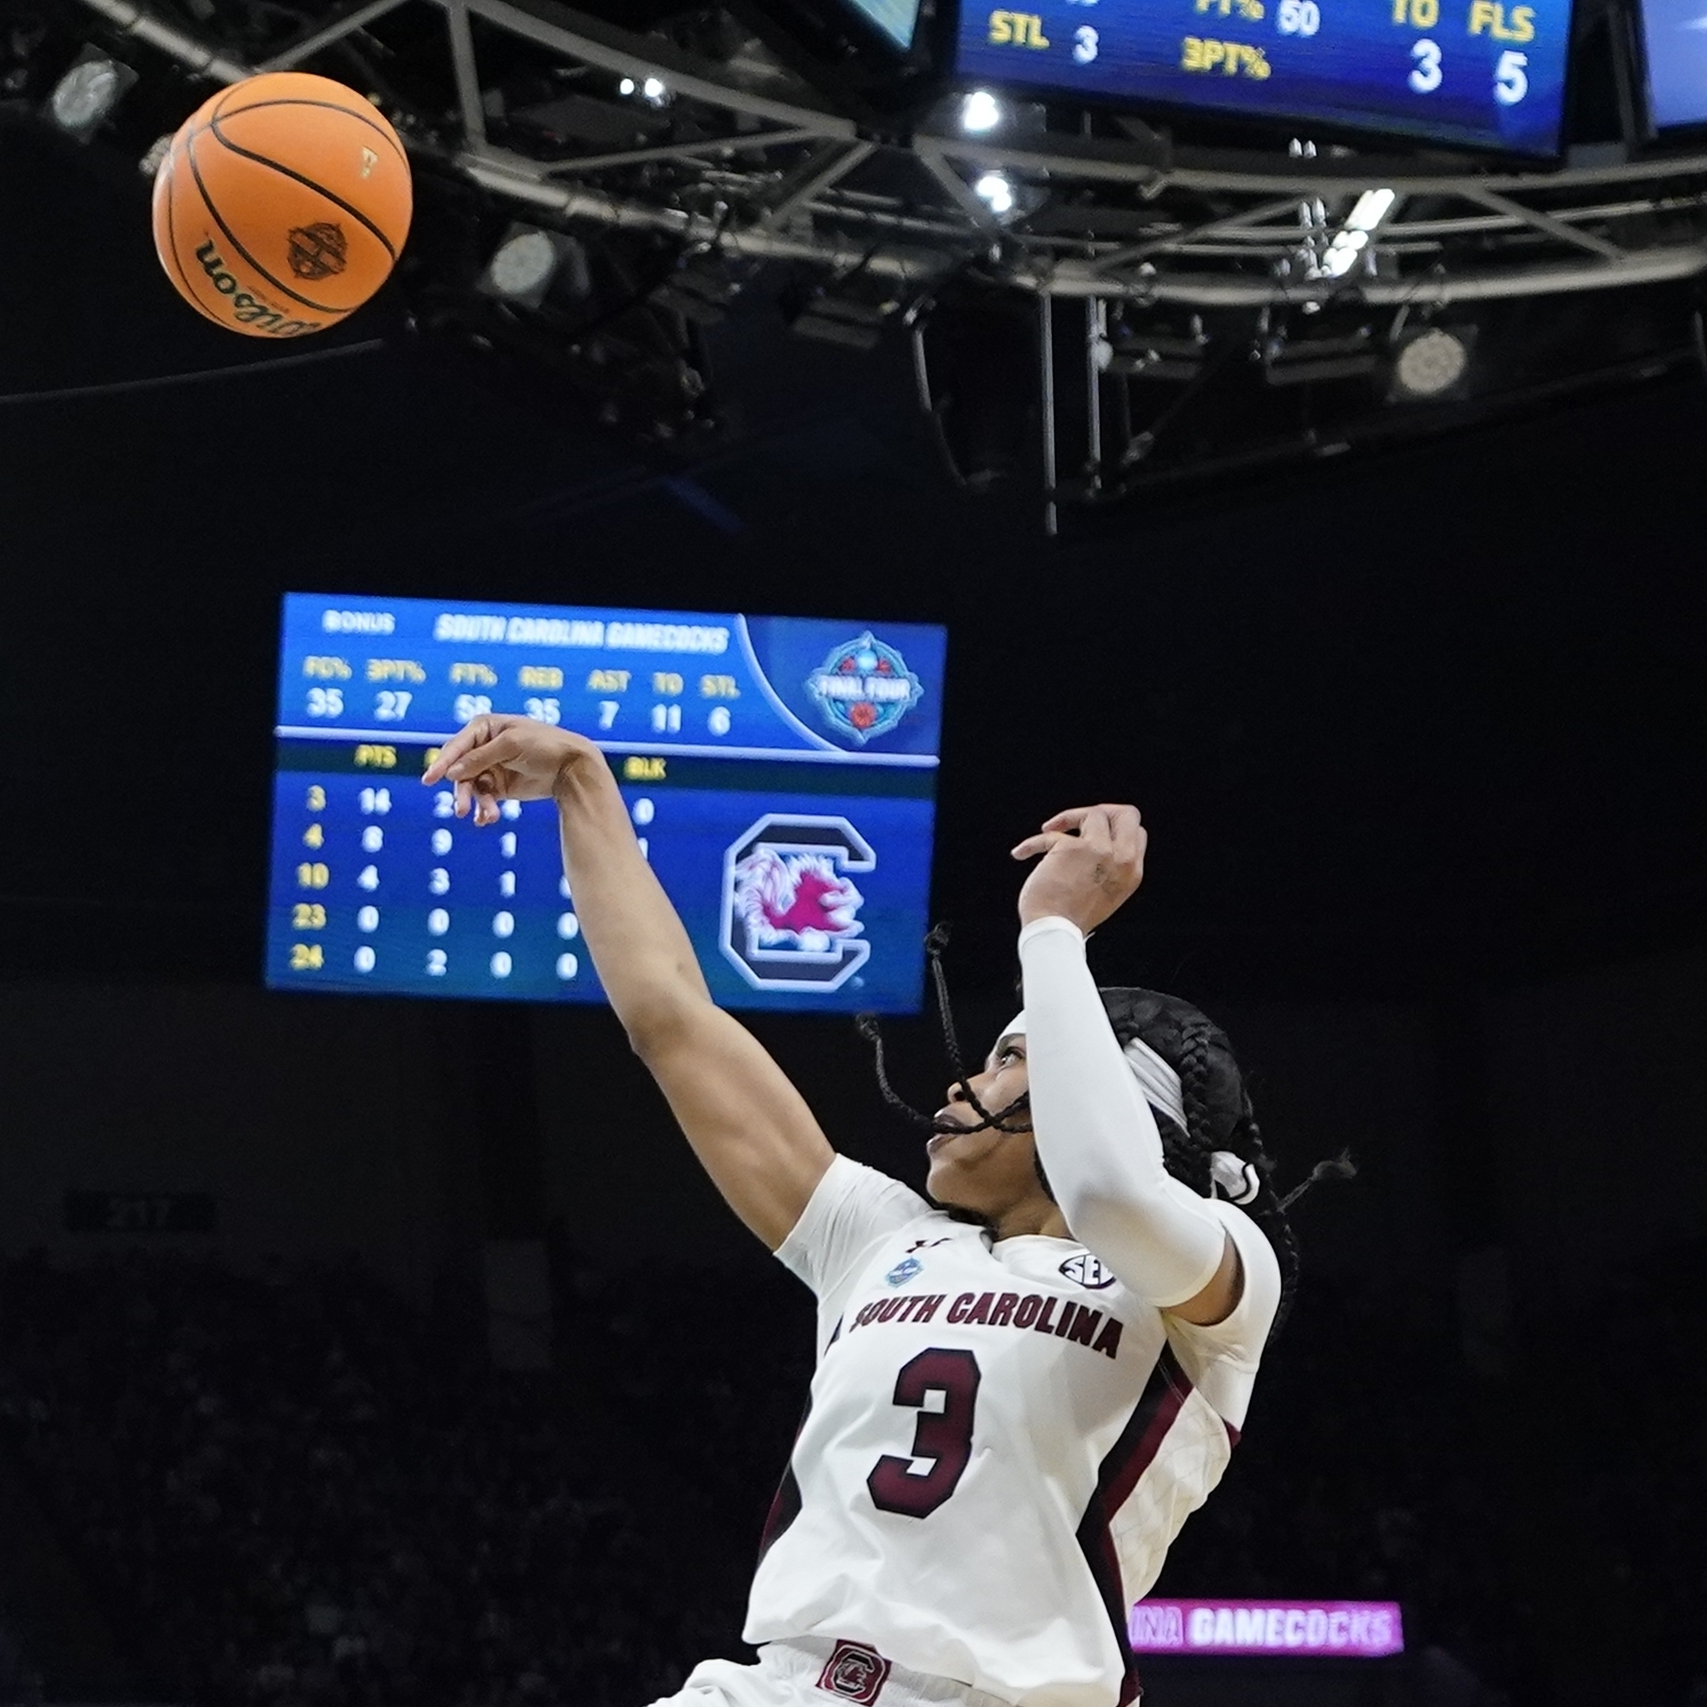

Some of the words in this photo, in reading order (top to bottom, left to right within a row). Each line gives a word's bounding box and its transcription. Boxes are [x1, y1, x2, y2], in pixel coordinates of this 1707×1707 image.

[989, 10, 1050, 49] STL
[1073, 25, 1099, 63] 3
[1468, 0, 1535, 42] FLS
[1182, 36, 1271, 80] 3PT%
[1409, 38, 1442, 93] 3
[1494, 50, 1528, 105] 5
[322, 610, 396, 635] BONUS
[437, 613, 507, 643] SOUTH
[508, 616, 604, 647] CAROLINA
[605, 621, 730, 655] GAMECOCKS
[303, 655, 352, 680] FG%
[366, 658, 426, 683] 3PT%
[518, 665, 564, 690] REB
[588, 669, 632, 693] AST
[653, 672, 683, 695] TO
[818, 675, 863, 700] FINAL
[864, 677, 911, 701] FOUR
[306, 688, 344, 718] 35
[375, 690, 413, 721] 27
[599, 700, 620, 730] 7
[651, 703, 682, 734] 11
[708, 706, 731, 736] 6
[354, 744, 397, 768] PTS
[624, 756, 667, 780] BLK
[306, 785, 327, 812] 3
[632, 797, 655, 825] 0
[303, 823, 325, 850] 4
[500, 831, 517, 858] 1
[296, 862, 330, 889] 10
[357, 864, 380, 893] 4
[429, 867, 451, 895] 3
[499, 870, 517, 898] 1
[357, 905, 380, 933] 0
[428, 908, 451, 936] 0
[492, 911, 515, 938] 0
[557, 912, 579, 940] 0
[354, 945, 377, 973] 0
[425, 948, 447, 977] 2
[489, 951, 512, 979] 0
[556, 952, 579, 980] 0
[850, 1292, 947, 1335] SOUTH
[947, 1292, 1125, 1360] CAROLINA
[866, 1347, 982, 1519] 3
[1190, 1607, 1391, 1649] GAMECOCKS
